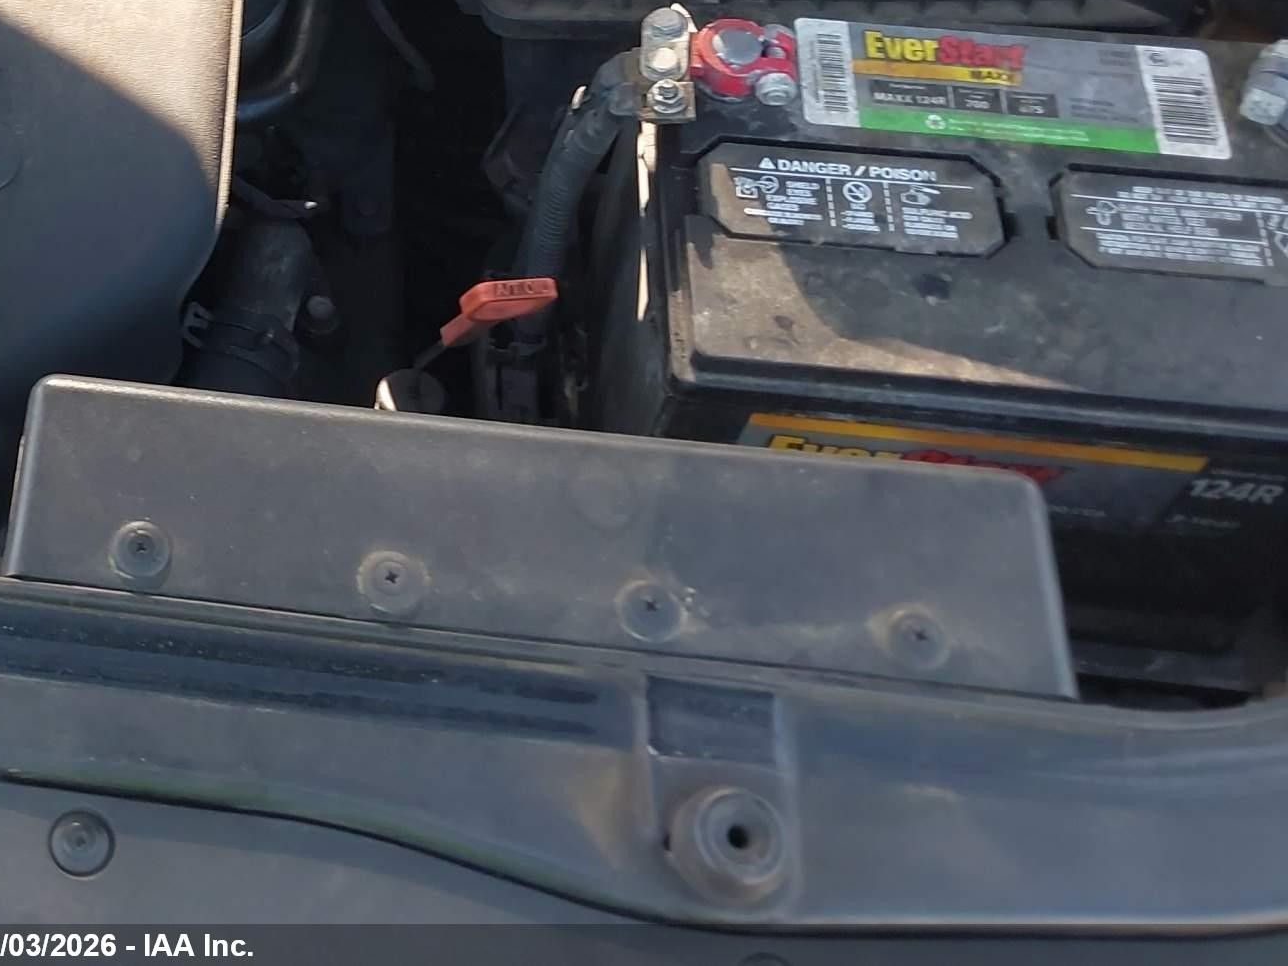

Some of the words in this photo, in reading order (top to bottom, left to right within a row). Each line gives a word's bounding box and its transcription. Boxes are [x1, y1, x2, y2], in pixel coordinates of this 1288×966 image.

[864, 30, 1025, 70] EverStart
[777, 158, 852, 177] DANGER
[853, 165, 866, 177] /
[868, 166, 938, 182] POISON
[1190, 477, 1284, 505] 124R
